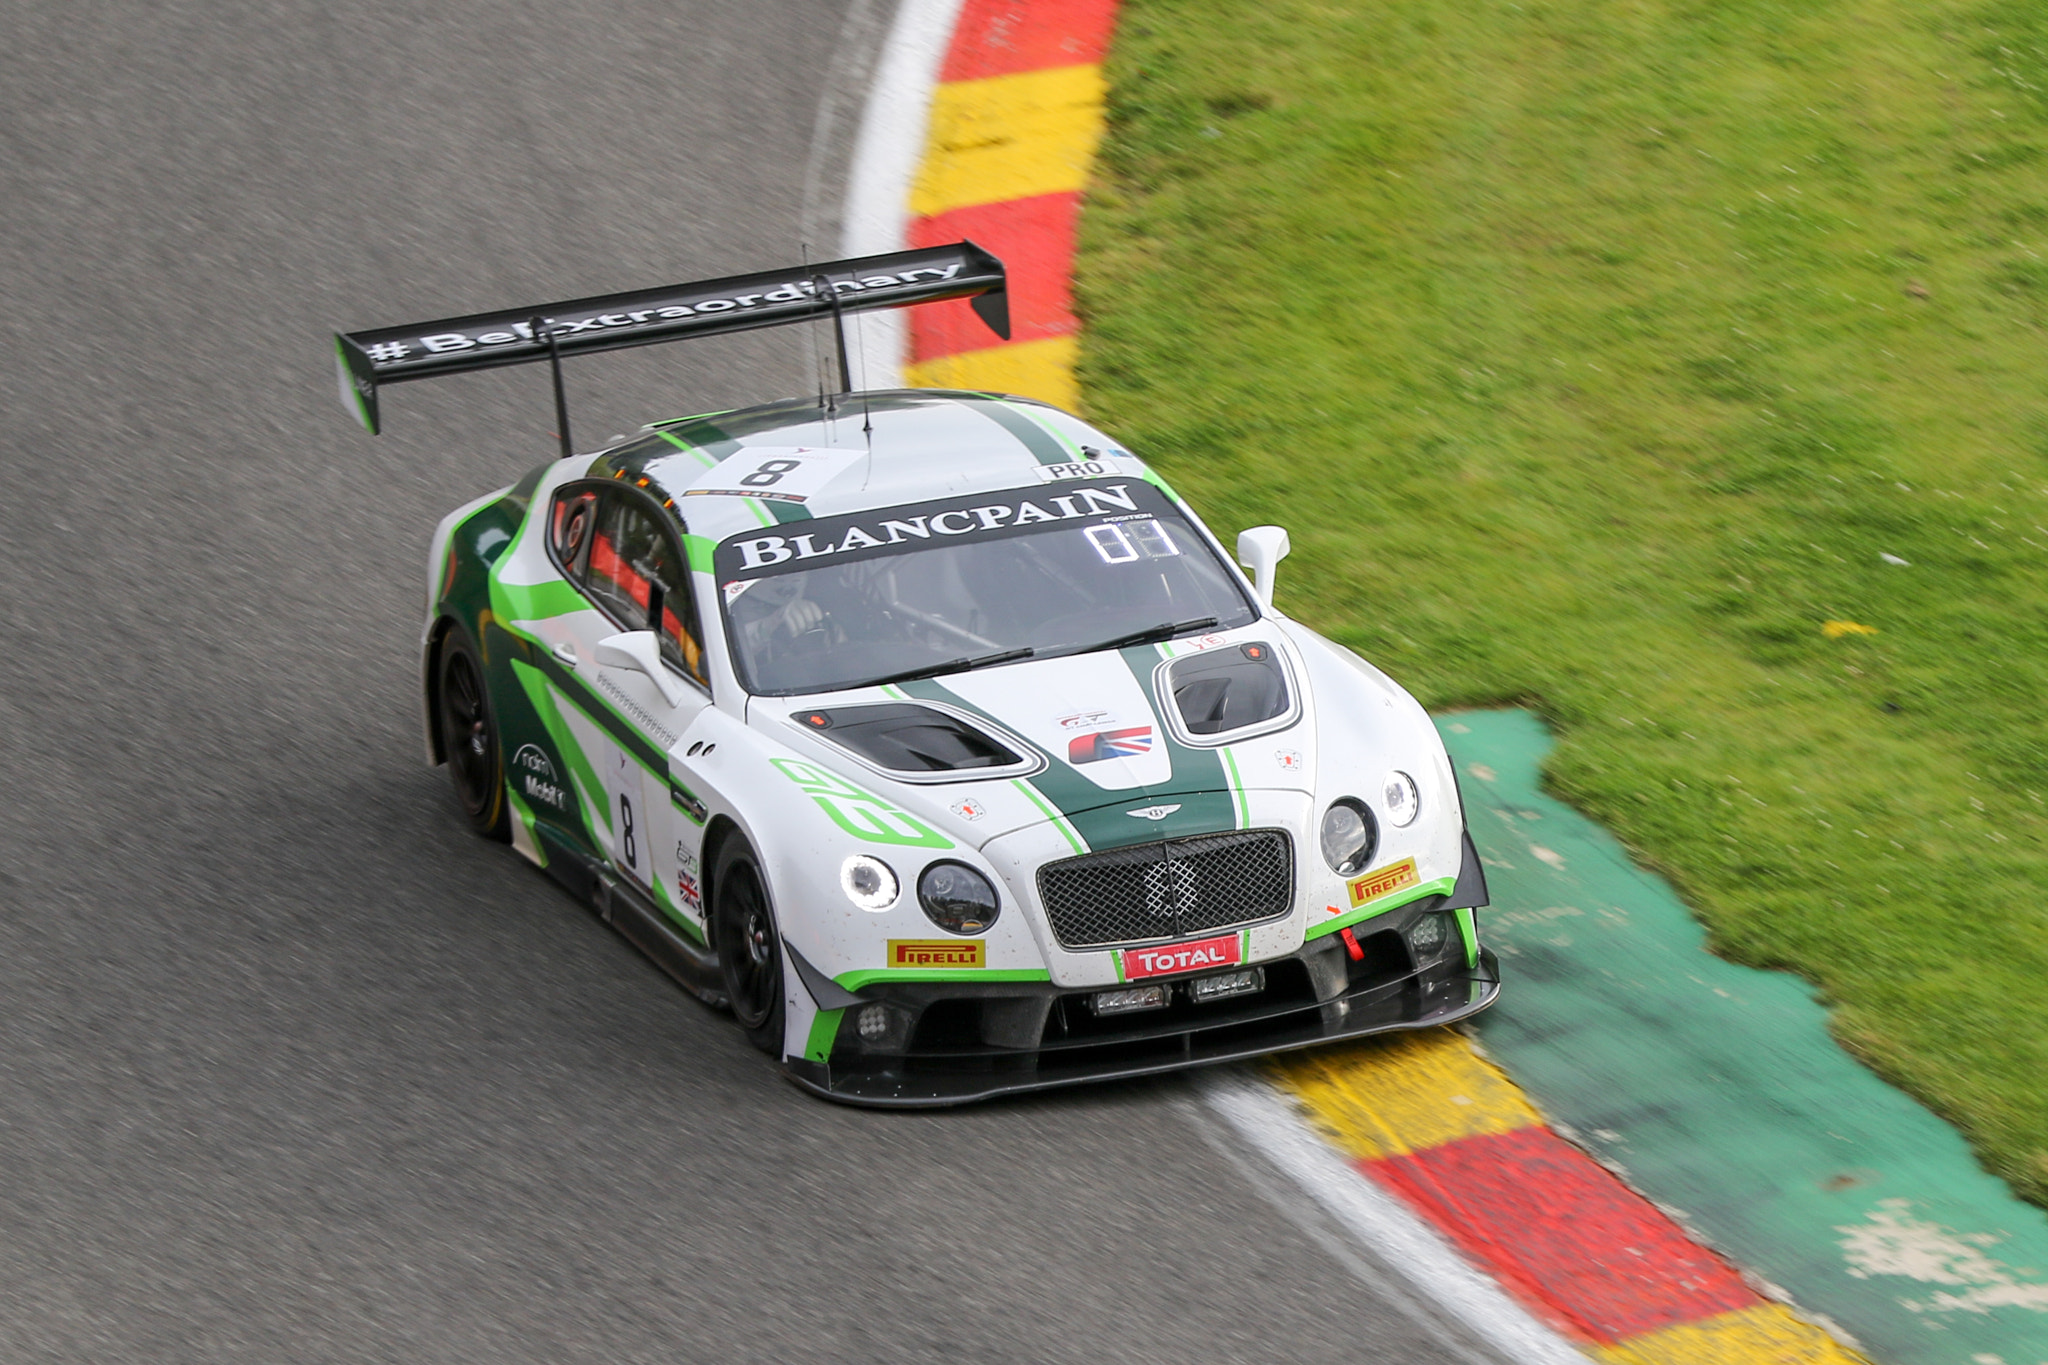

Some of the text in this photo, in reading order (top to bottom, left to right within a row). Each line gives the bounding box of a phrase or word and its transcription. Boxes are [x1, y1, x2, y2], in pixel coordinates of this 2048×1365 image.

[739, 459, 801, 487] 8
[1049, 461, 1105, 478] PRO
[1102, 513, 1153, 523] POSITION
[620, 793, 637, 870] 8
[1354, 864, 1414, 901] PIRELLI
[896, 945, 977, 963] PIRELLI
[1138, 947, 1226, 972] TOTAL
